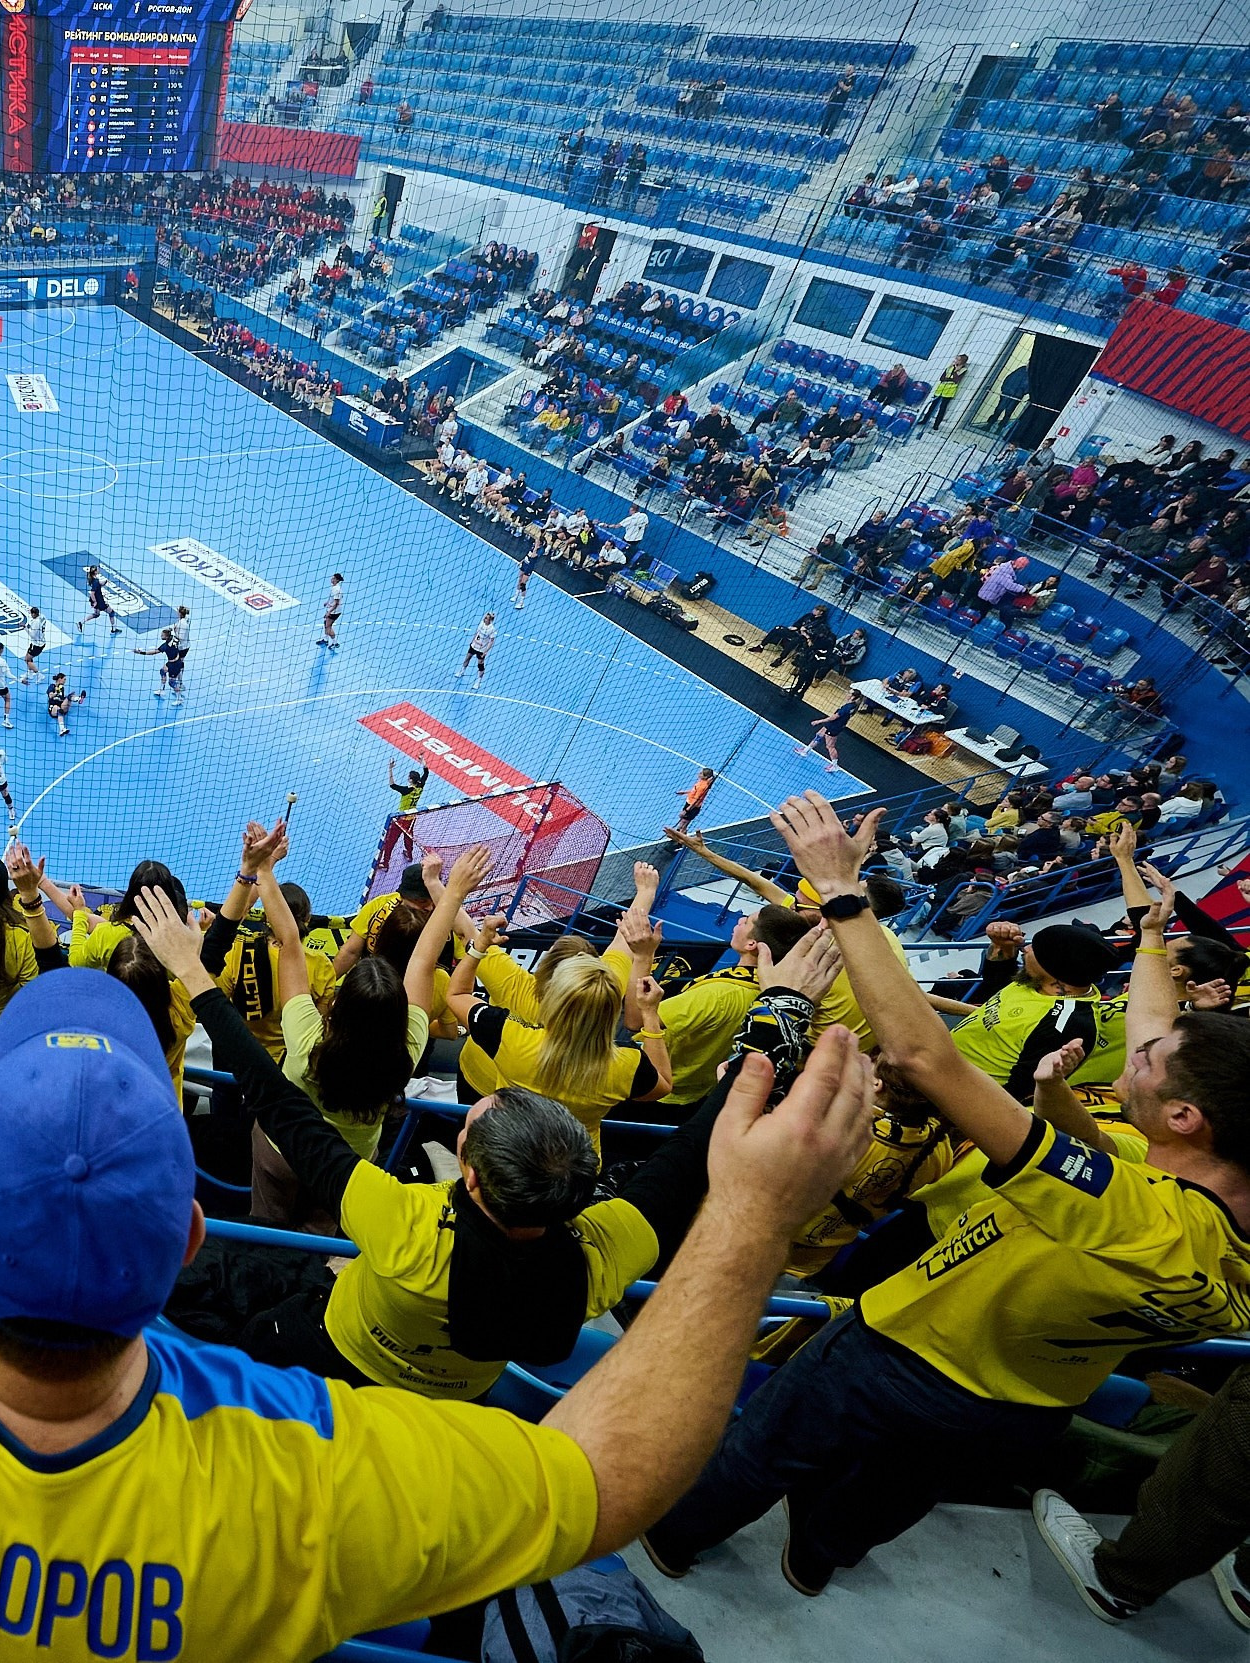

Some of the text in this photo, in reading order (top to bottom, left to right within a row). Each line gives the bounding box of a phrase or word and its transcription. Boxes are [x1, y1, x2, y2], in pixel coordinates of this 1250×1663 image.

[148, 5, 192, 14] РОСТОВ-ДОН
[64, 29, 198, 43] РЕЙТИНГ БОМБАРДИРОВ МАТЧА
[162, 544, 251, 596] РУСКОН
